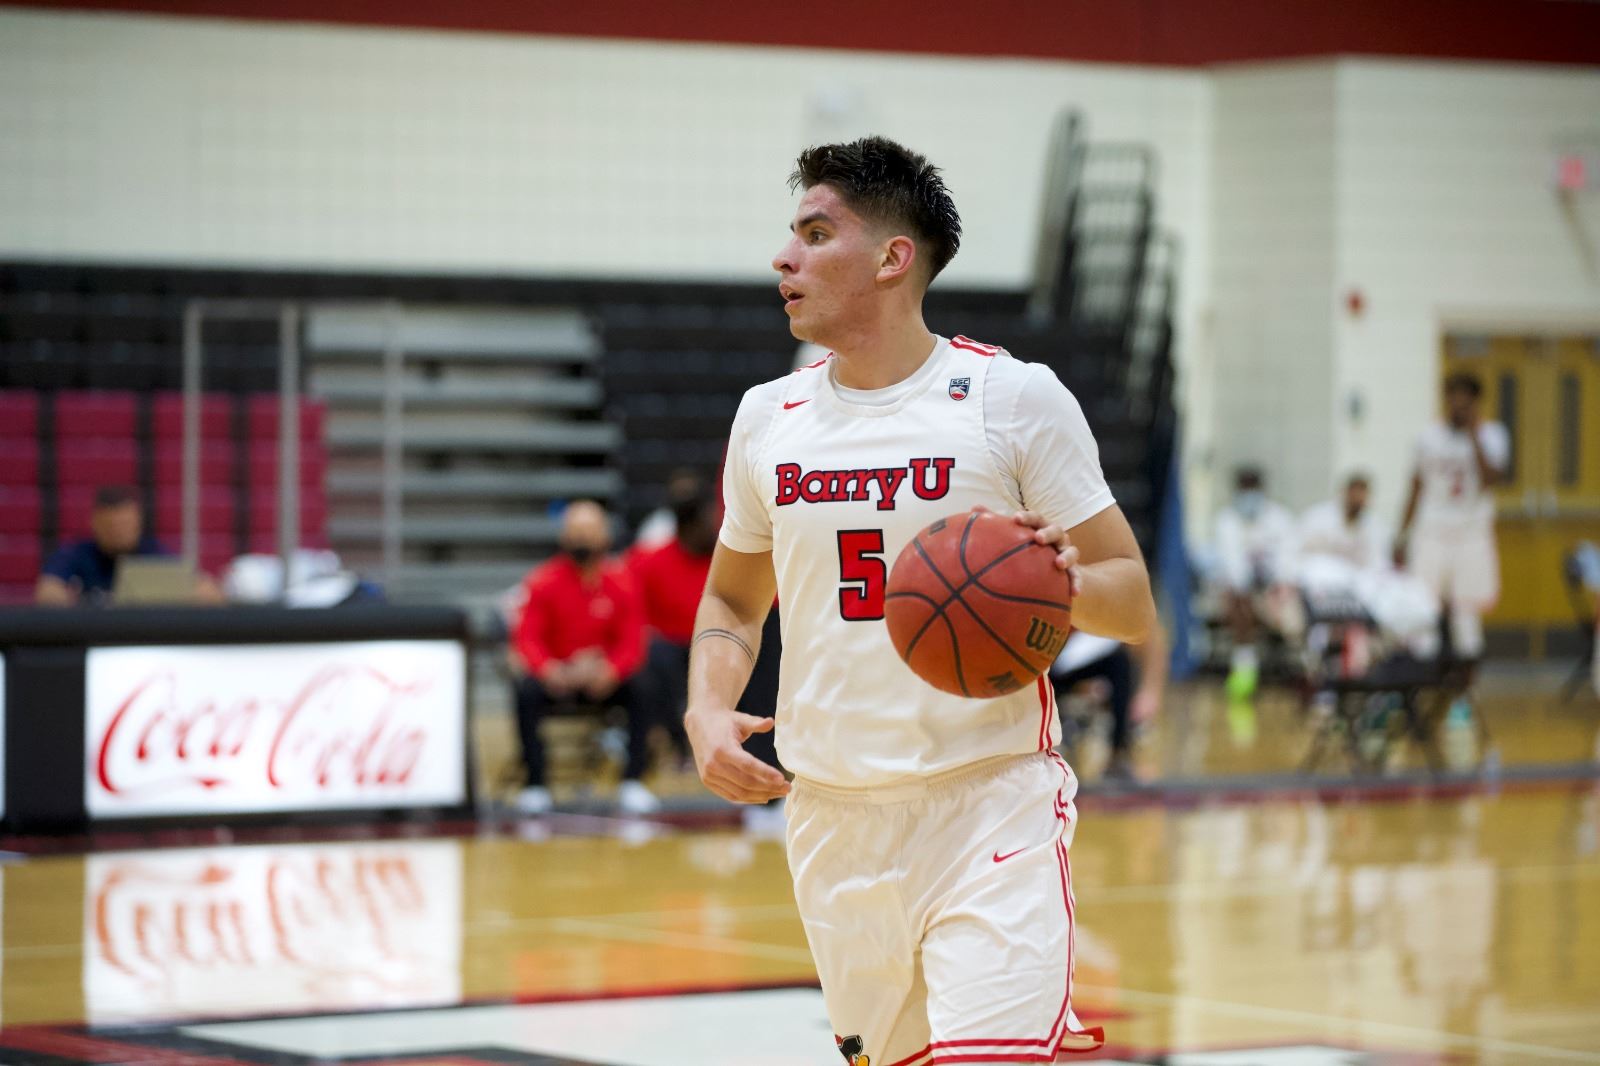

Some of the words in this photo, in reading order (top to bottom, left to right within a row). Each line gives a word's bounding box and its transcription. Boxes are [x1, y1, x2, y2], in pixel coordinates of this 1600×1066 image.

[775, 463, 907, 511] Barry
[909, 457, 956, 499] U
[837, 529, 887, 622] 5
